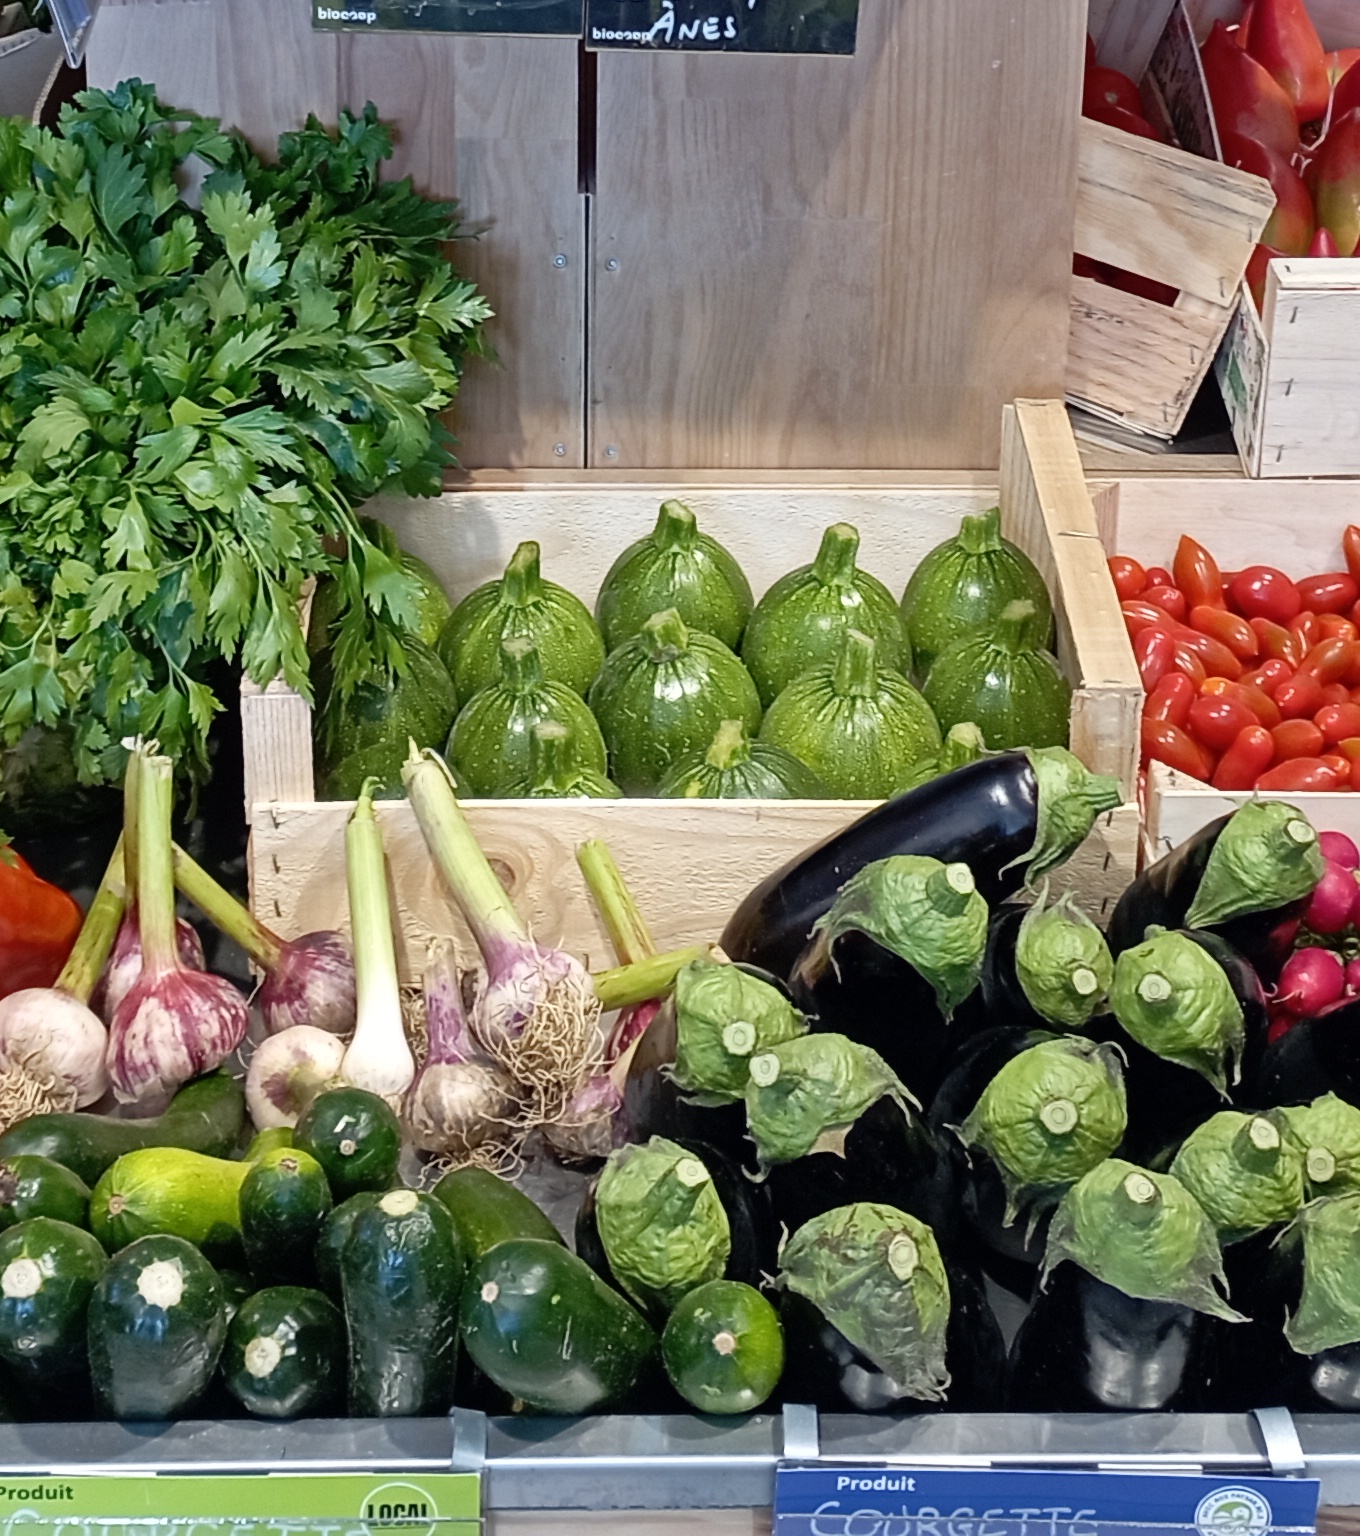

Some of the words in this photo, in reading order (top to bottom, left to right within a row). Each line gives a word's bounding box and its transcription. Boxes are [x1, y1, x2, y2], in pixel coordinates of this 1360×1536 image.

[318, 6, 376, 24] biocoop
[592, 26, 651, 42] biocoop
[837, 1476, 916, 1492] Produit
[367, 1503, 428, 1526] LOCAL
[810, 1500, 1098, 1536] COURGETTE
